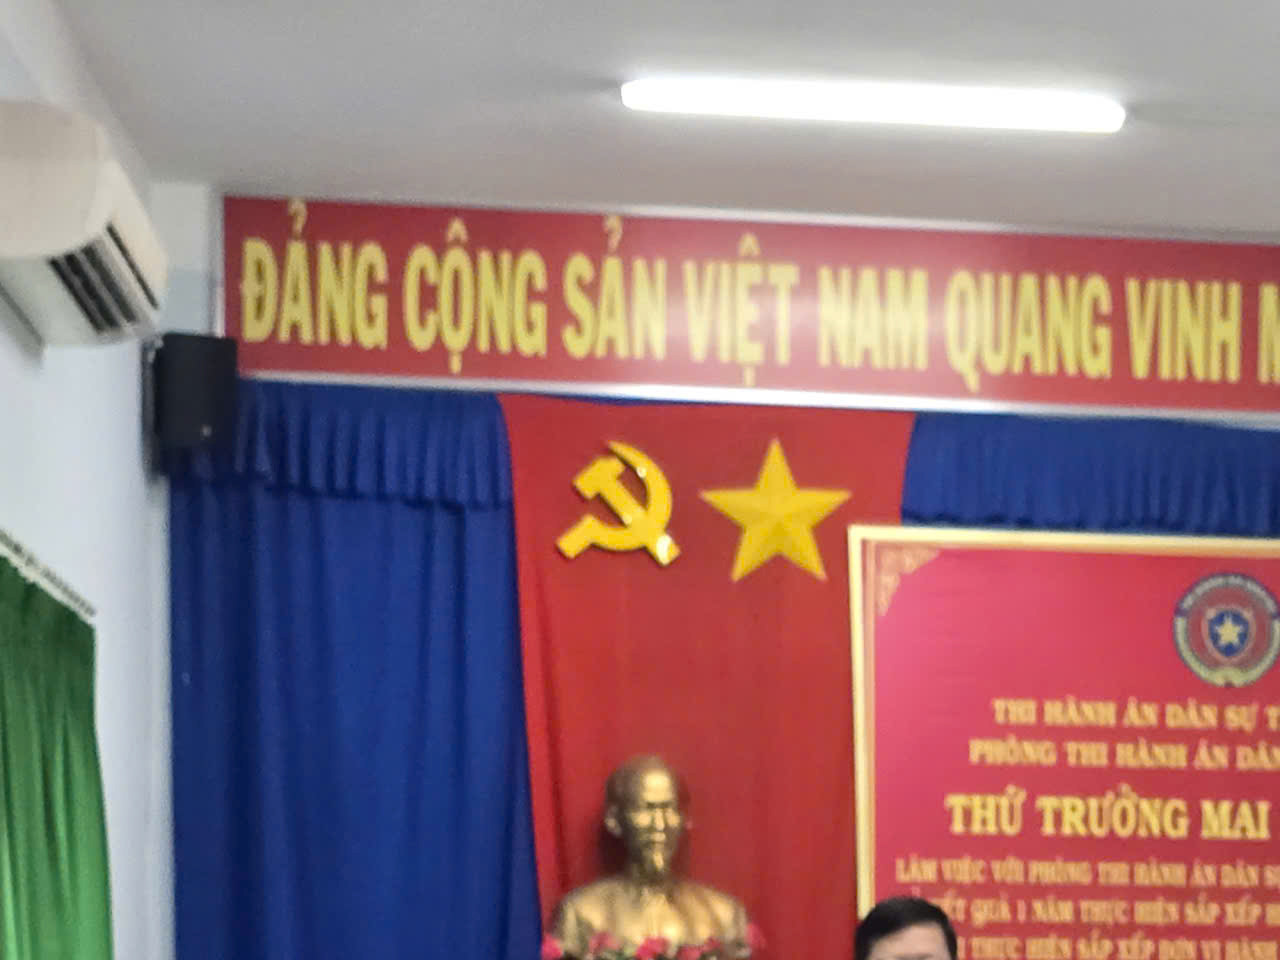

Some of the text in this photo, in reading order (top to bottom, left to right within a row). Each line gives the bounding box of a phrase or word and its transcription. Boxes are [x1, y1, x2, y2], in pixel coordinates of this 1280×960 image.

[241, 201, 389, 348] ĐẢNG
[404, 217, 548, 374] CỘNG
[562, 215, 667, 360] SẢN
[683, 232, 799, 387] VIỆT
[817, 264, 930, 371] NAM
[944, 268, 1113, 391] QUANG
[1124, 277, 1243, 382] VINH
[993, 698, 1037, 725] THI
[1044, 694, 1116, 726] HÀNH
[1123, 696, 1158, 727] ÁN
[1165, 697, 1218, 729] DÂN
[1224, 702, 1258, 734] SỰ
[968, 734, 1057, 766] PHÒNG
[1065, 740, 1109, 767] THI
[1116, 736, 1188, 768] HÀNH
[1194, 738, 1229, 770] ÁN
[945, 784, 1027, 836] THỨ
[1035, 782, 1190, 838] TRƯỞNG
[1200, 798, 1270, 840] MAI
